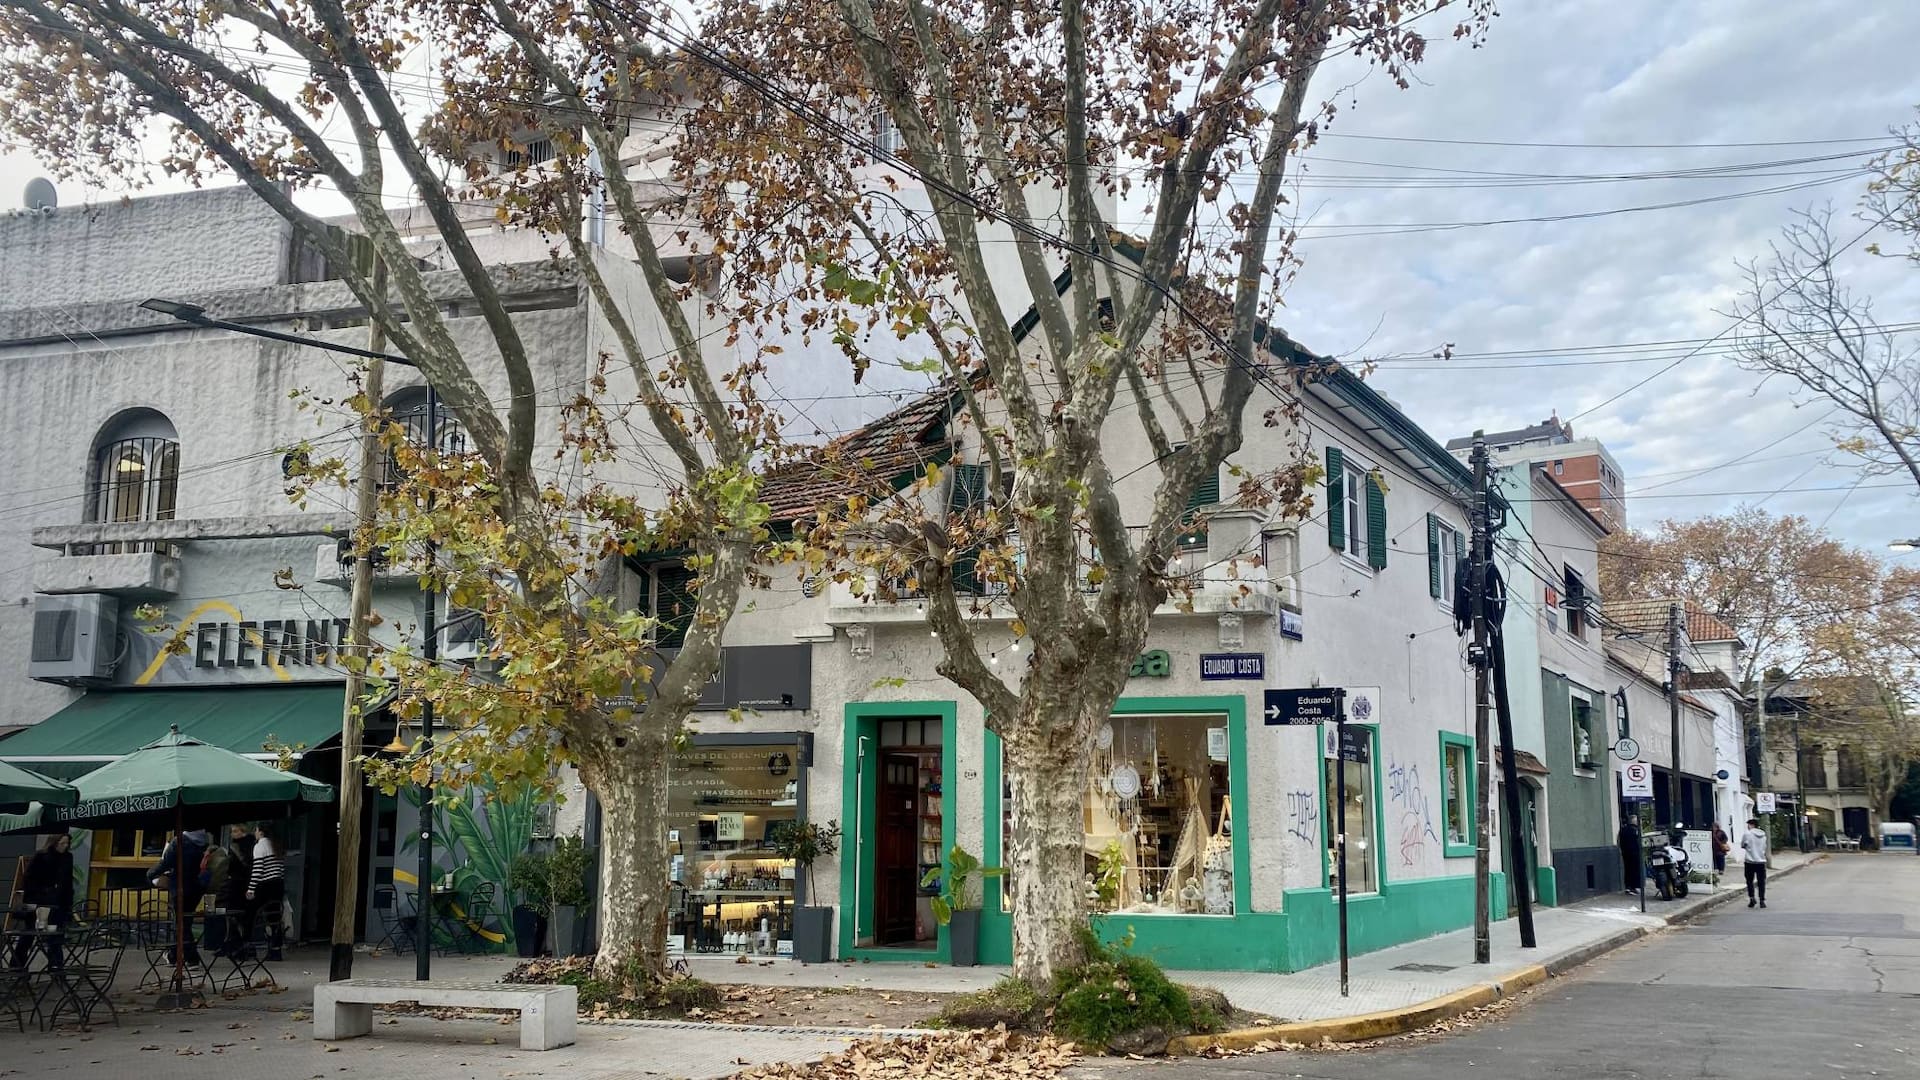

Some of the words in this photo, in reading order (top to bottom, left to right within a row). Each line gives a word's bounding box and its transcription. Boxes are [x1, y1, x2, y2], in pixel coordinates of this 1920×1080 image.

[195, 619, 371, 668] ELEFANT
[1128, 649, 1170, 677] ca
[1203, 659, 1235, 675] EDUARDO
[1237, 658, 1261, 674] COSTA
[1297, 696, 1332, 705] Eduardo
[1297, 706, 1322, 715] Costa
[709, 751, 728, 760] DEL
[752, 751, 784, 760] HUMO
[1632, 768, 1640, 777] E
[695, 778, 725, 786] MAGIA
[692, 788, 698, 796] A
[738, 787, 755, 796] DEL
[757, 786, 786, 796] TIEMP
[56, 790, 169, 821] Heineken
